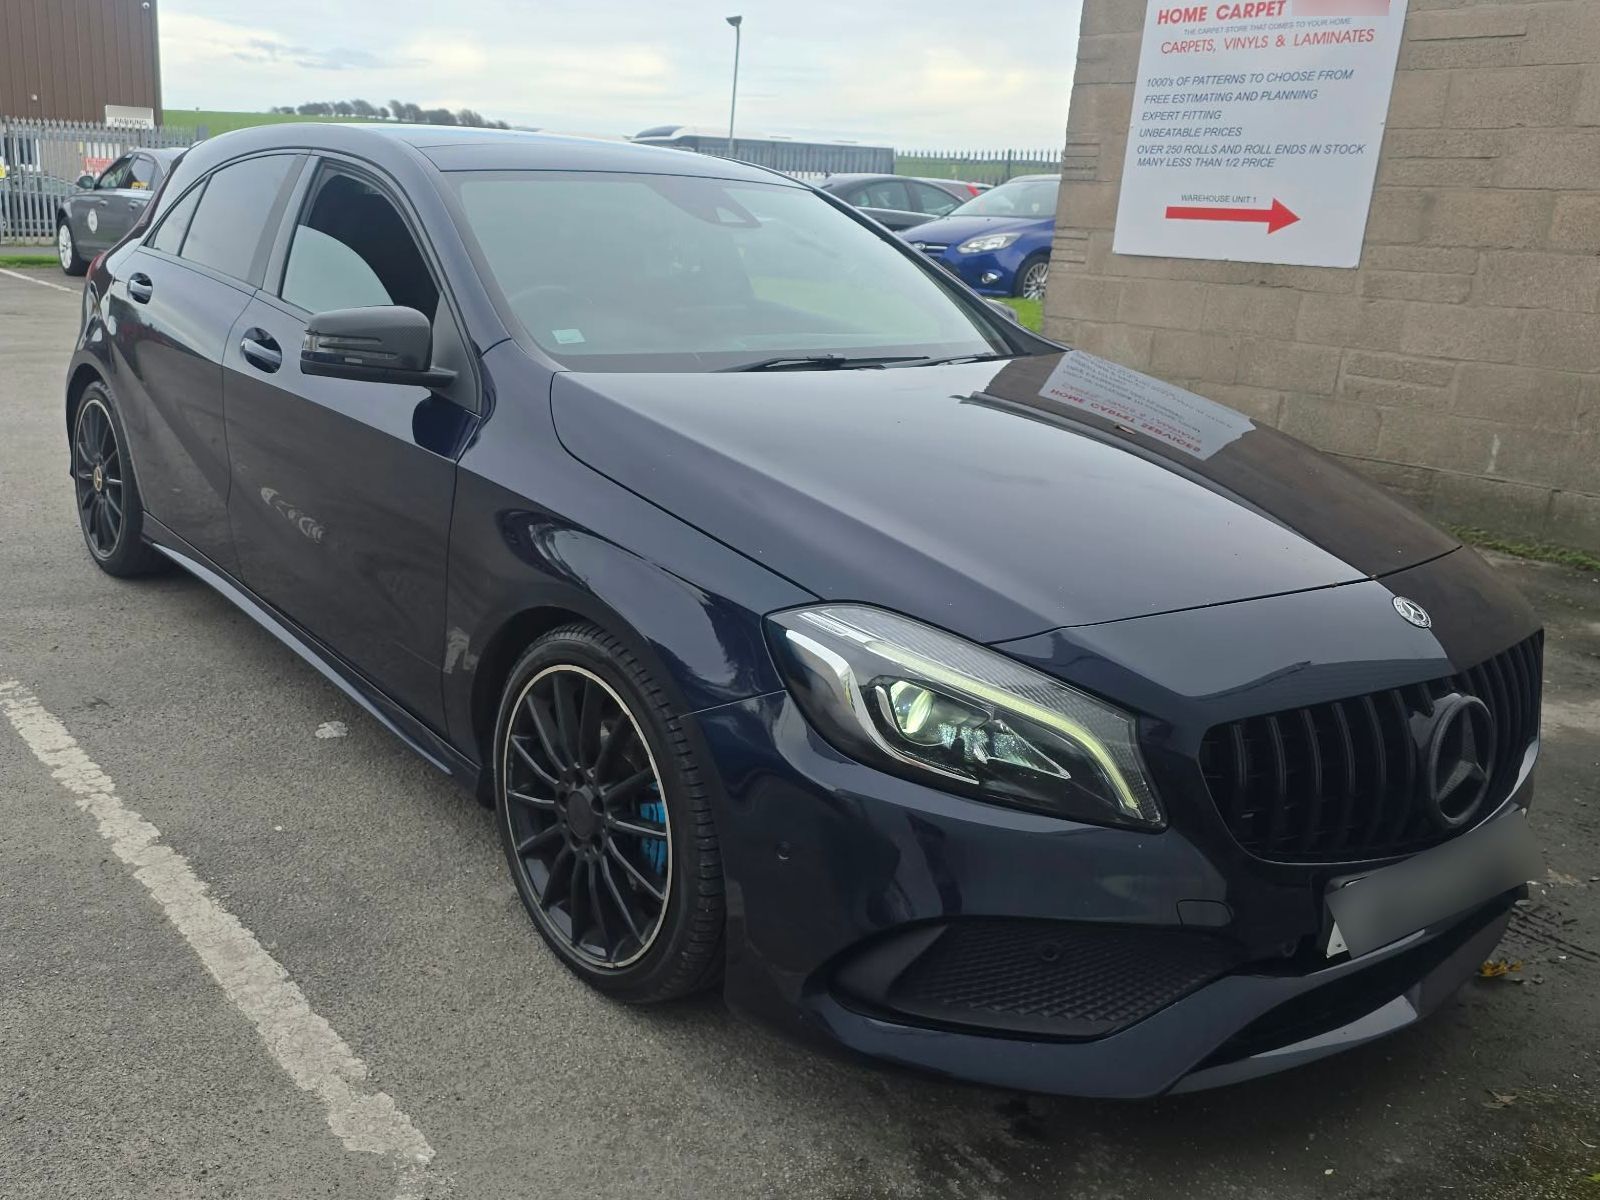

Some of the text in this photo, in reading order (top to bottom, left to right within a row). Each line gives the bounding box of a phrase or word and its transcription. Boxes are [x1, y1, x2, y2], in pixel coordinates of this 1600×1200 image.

[1157, 0, 1286, 24] HOME CARPET
[1184, 28, 1196, 36] THE
[1198, 27, 1224, 35] CARPET
[1224, 25, 1248, 33] STORE
[1268, 21, 1294, 30] COMES
[1307, 20, 1329, 28] YOUR
[1329, 17, 1352, 26] HOME
[1161, 28, 1376, 54] CARPETS, VINYLS & LAMINATES
[1147, 69, 1354, 88] 1000's OF PATTERNS TO CHOOSE FROM
[1144, 89, 1319, 104] FREE ESTIMATING AND PLANNING
[1142, 110, 1222, 121] EXPERT FITTING
[1140, 127, 1242, 138] UNBEATABLE PRICES
[1137, 144, 1367, 155] OVER 250 ROLLS AND ROLL ENDS IN STOCK
[1137, 157, 1276, 168] MANY LESS THAN 1/2 PRICE
[1181, 194, 1231, 202] WAREHOUSE
[1232, 195, 1251, 203] UNIT
